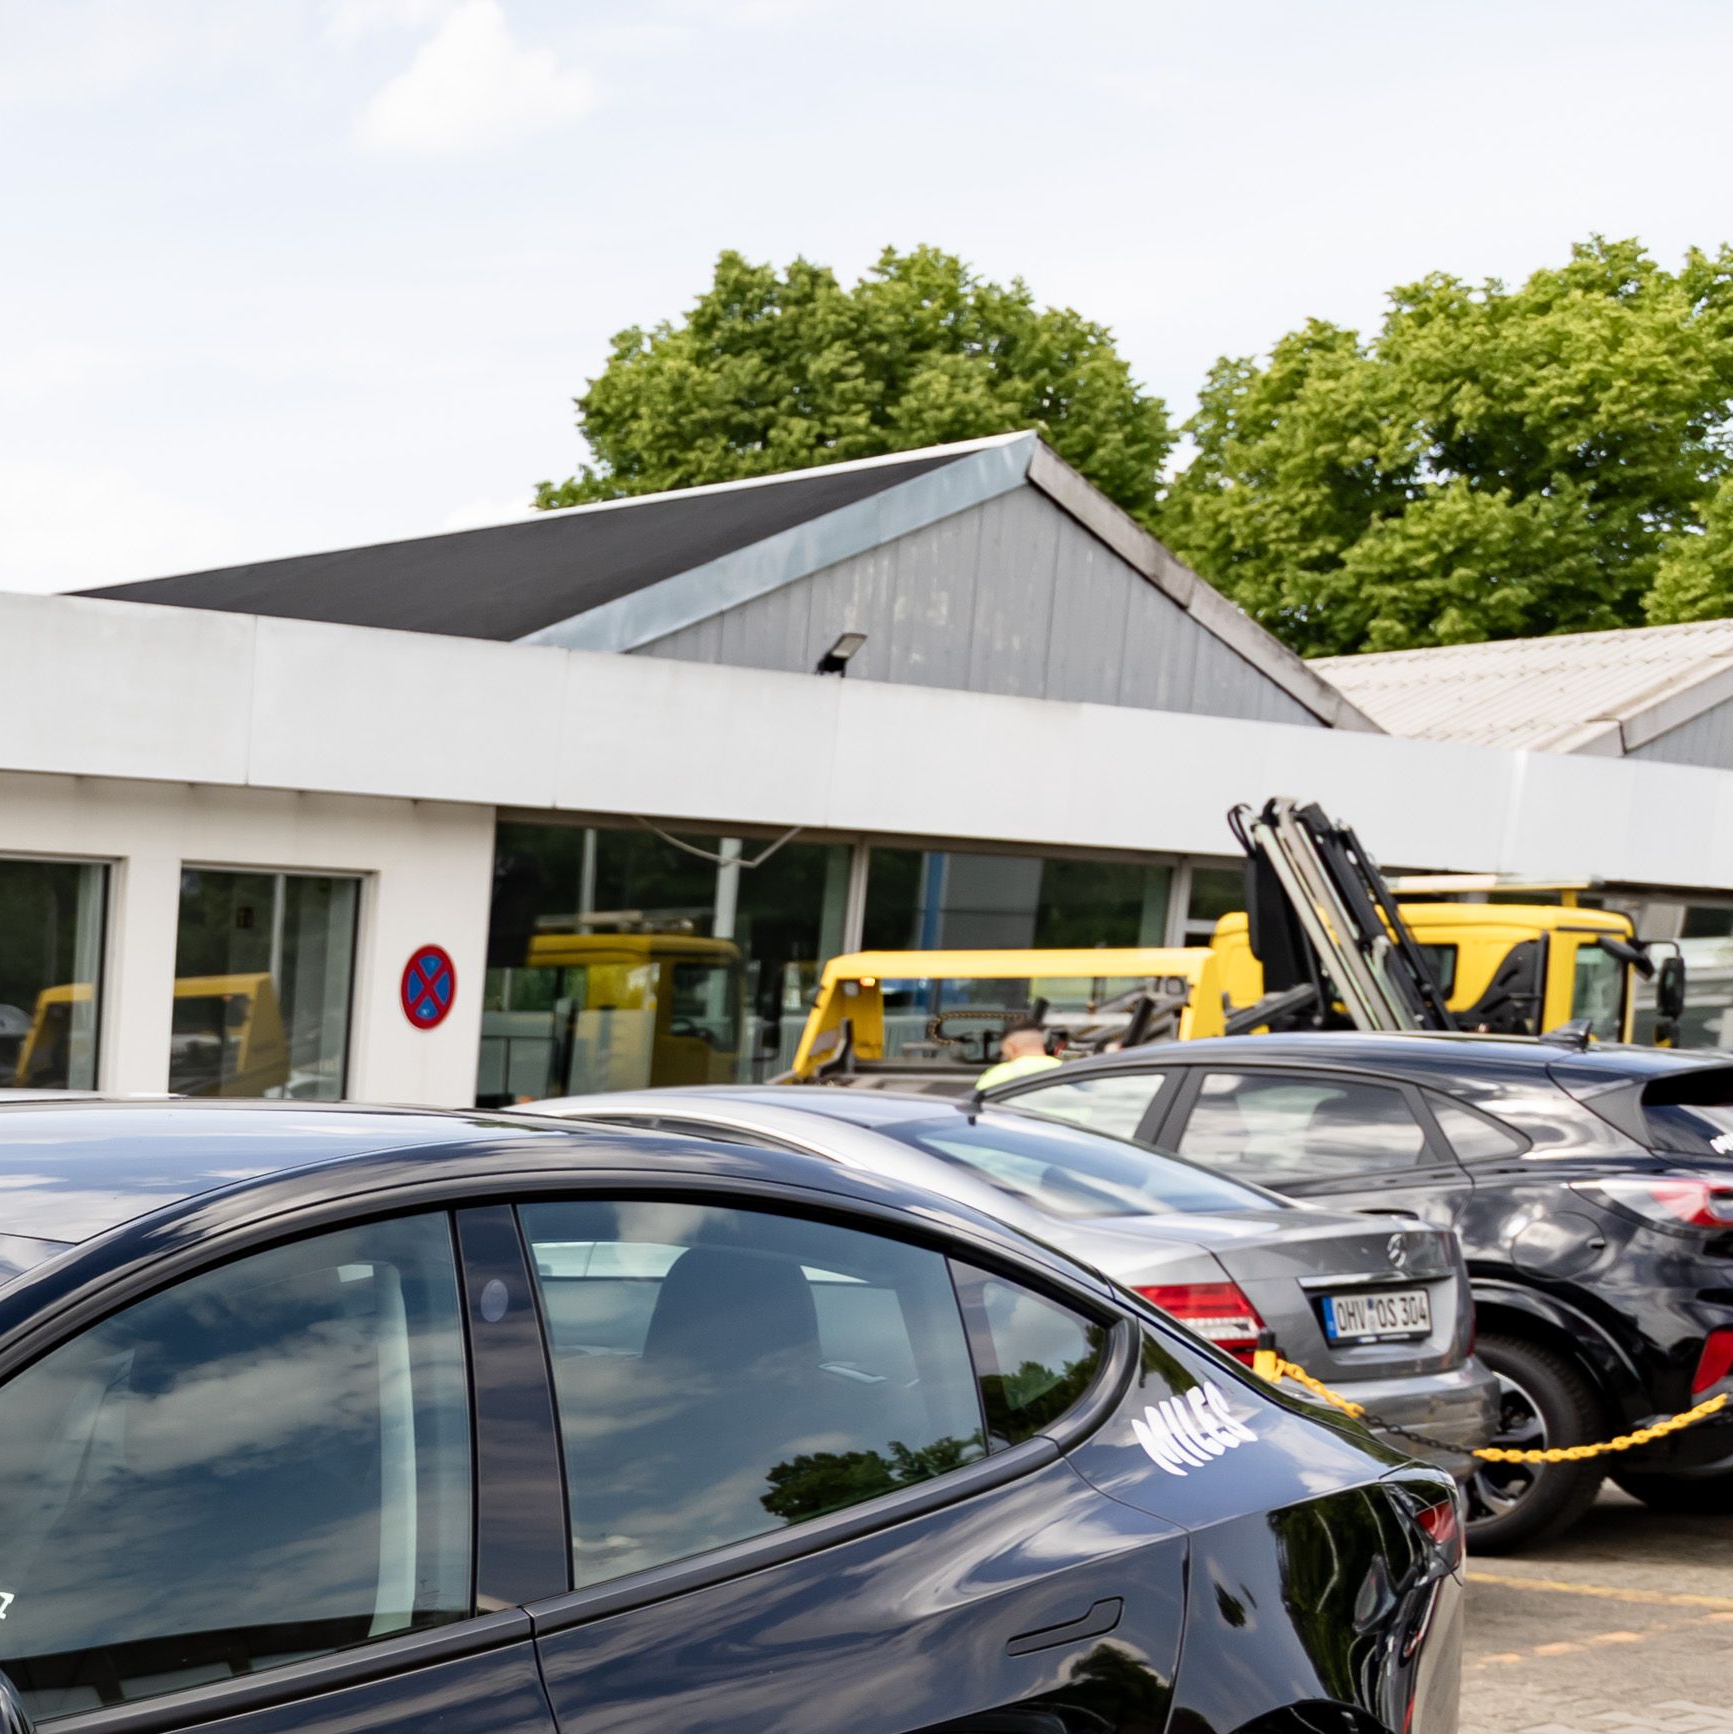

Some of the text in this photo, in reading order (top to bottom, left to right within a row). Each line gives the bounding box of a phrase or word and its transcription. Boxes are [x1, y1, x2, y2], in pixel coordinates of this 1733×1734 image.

[1336, 1296, 1427, 1331] OHV OS 304
[1131, 1381, 1259, 1477] MILES
